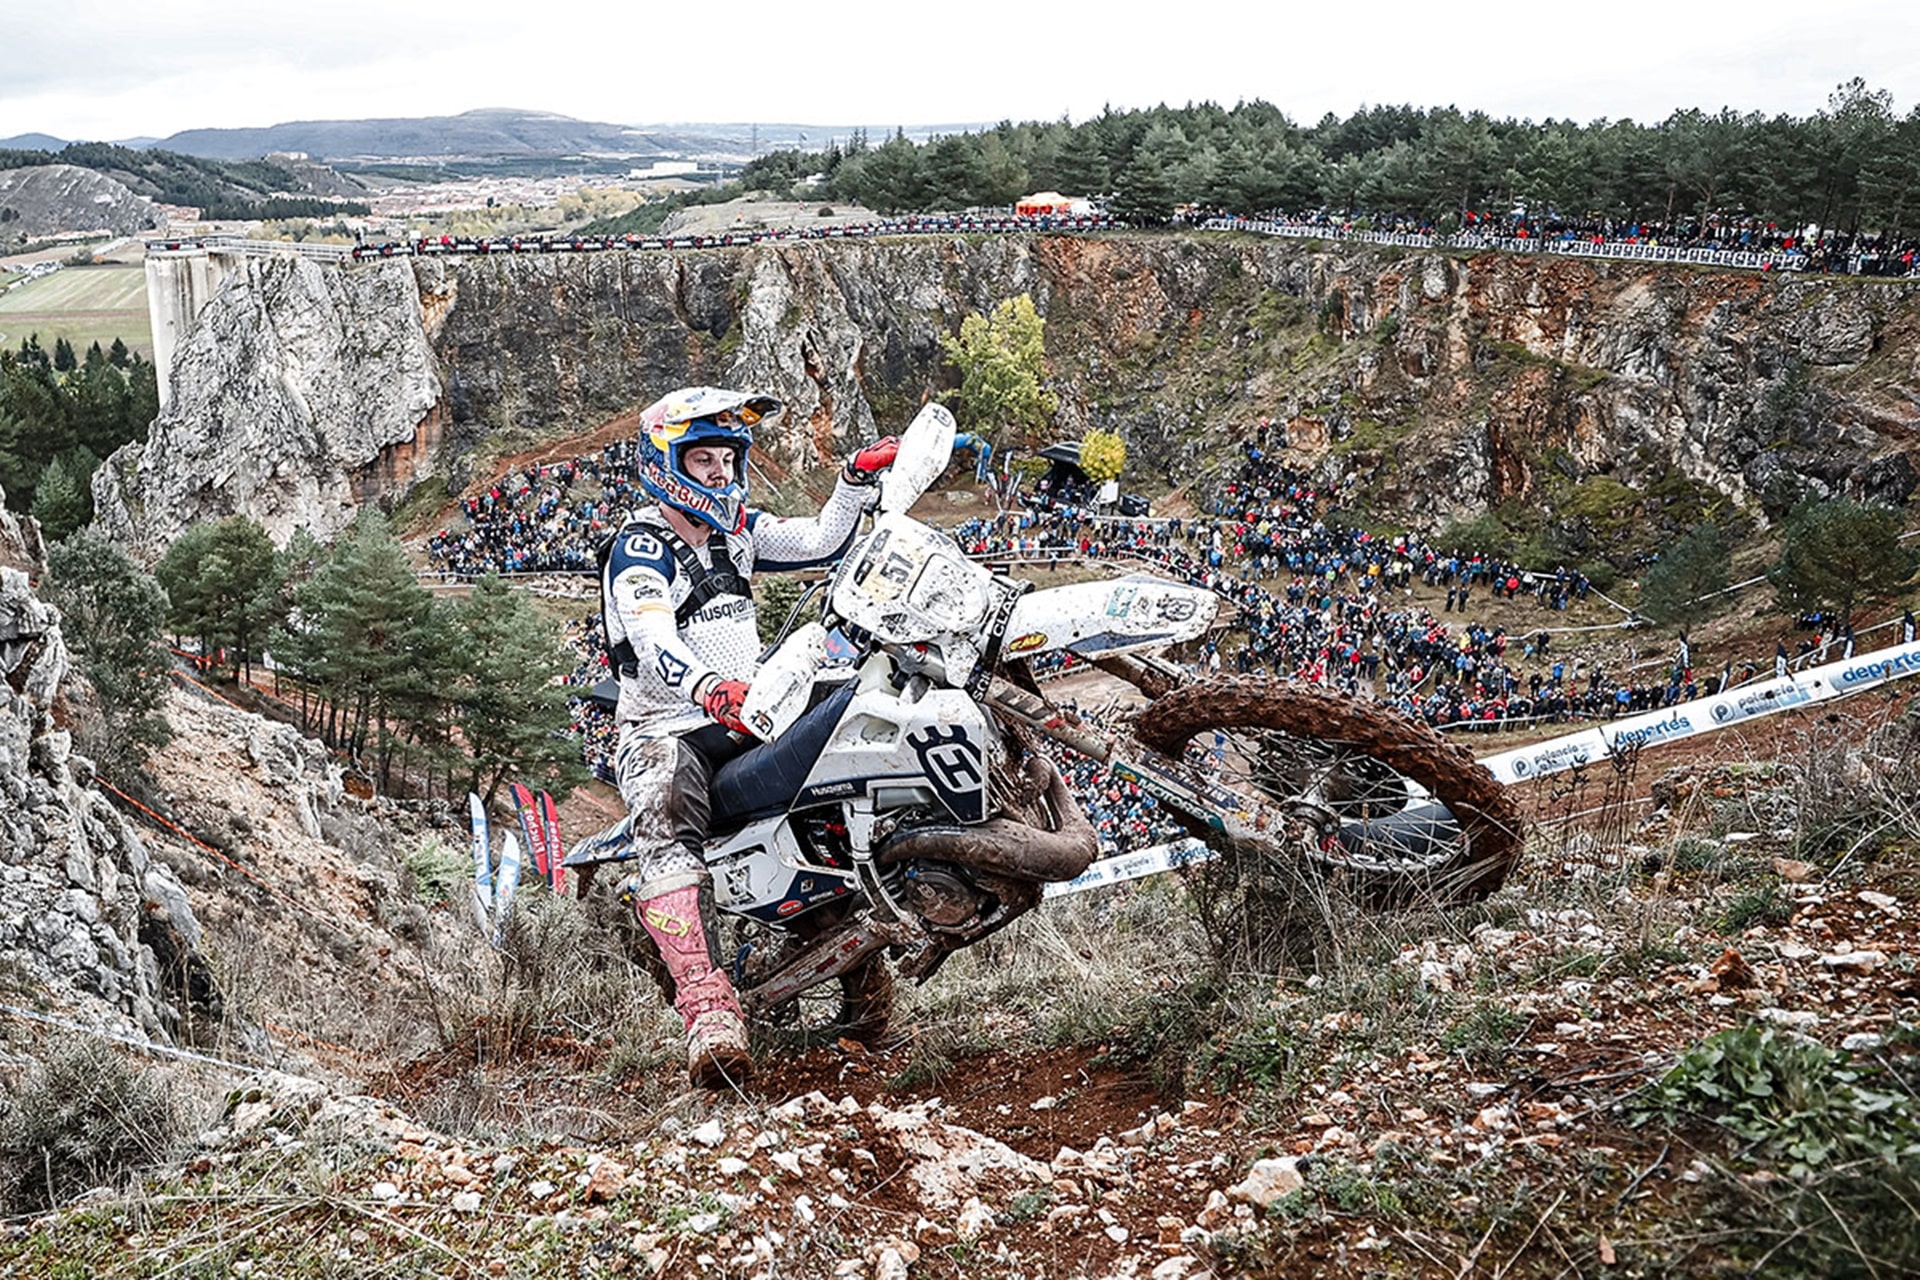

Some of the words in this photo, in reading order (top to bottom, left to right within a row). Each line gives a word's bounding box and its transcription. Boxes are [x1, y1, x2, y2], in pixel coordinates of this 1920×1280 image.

[649, 463, 677, 495] Red
[677, 488, 712, 513] Bull
[880, 551, 914, 584] 57
[1738, 684, 1795, 709] palecia
[1138, 779, 1214, 823] MOTOREX
